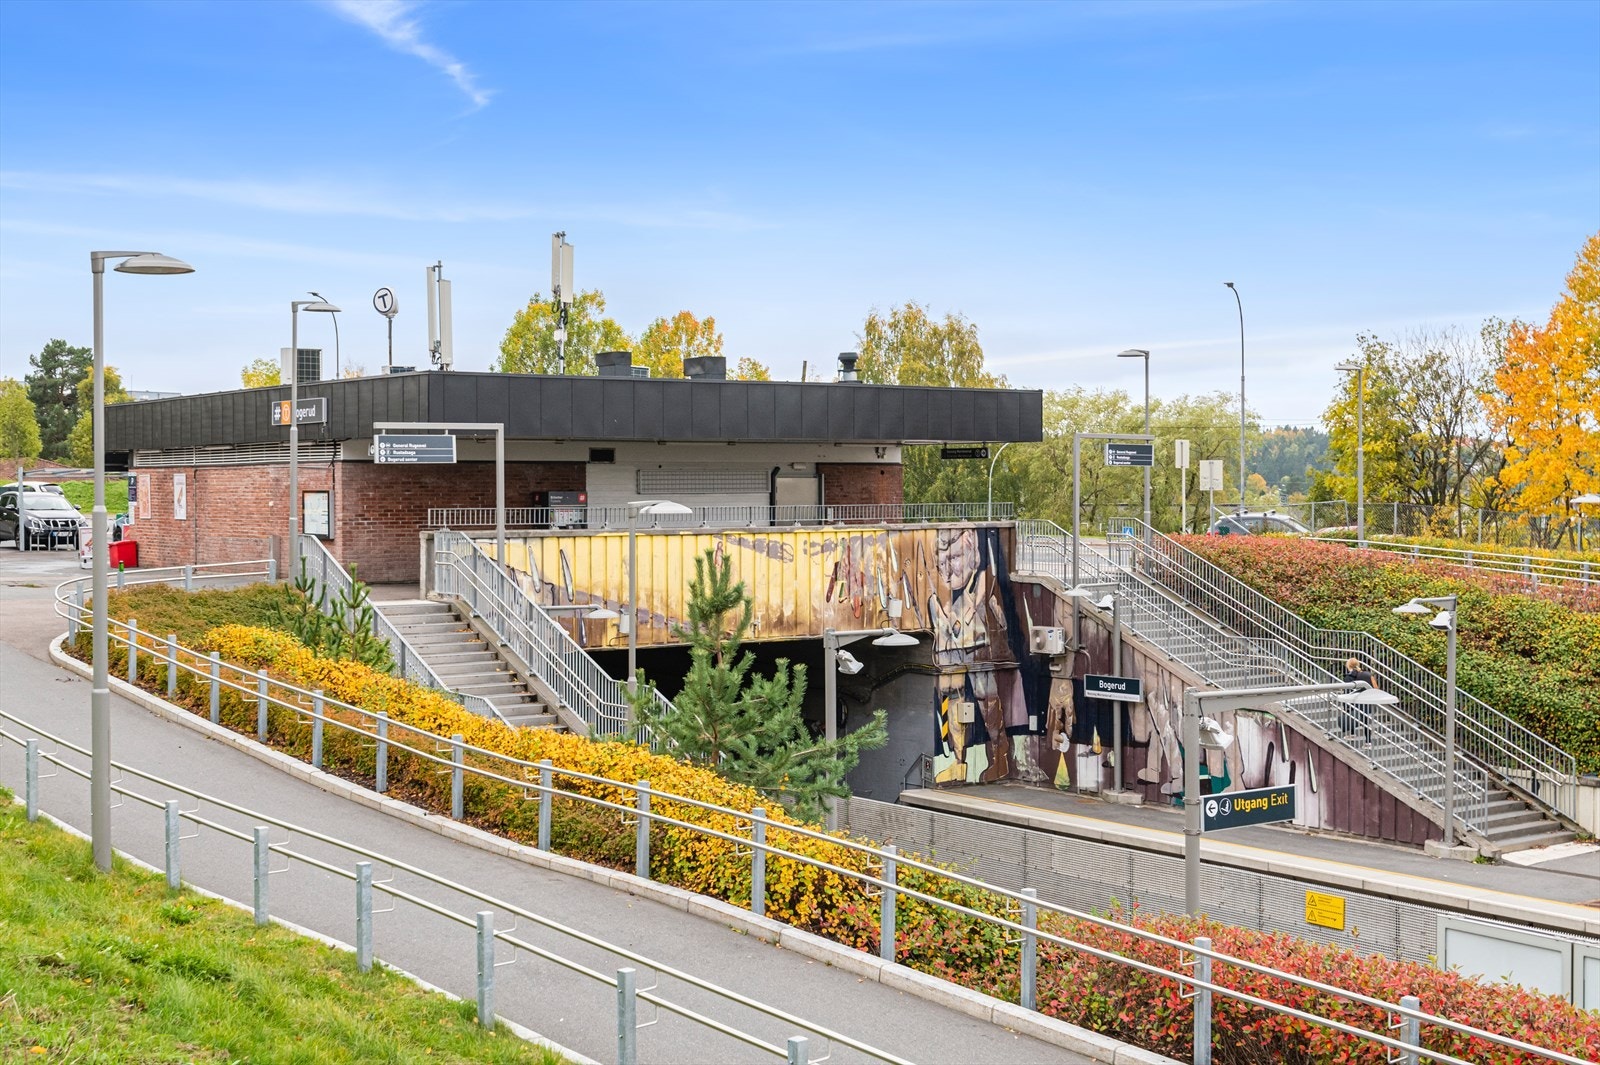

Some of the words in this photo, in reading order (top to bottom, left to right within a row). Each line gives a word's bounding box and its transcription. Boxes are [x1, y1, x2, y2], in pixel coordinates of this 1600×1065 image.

[377, 292, 388, 309] T
[296, 404, 316, 421] ogerud
[1099, 679, 1126, 691] Bogerud
[1233, 797, 1269, 813] Utgang
[1270, 792, 1289, 806] Exit
